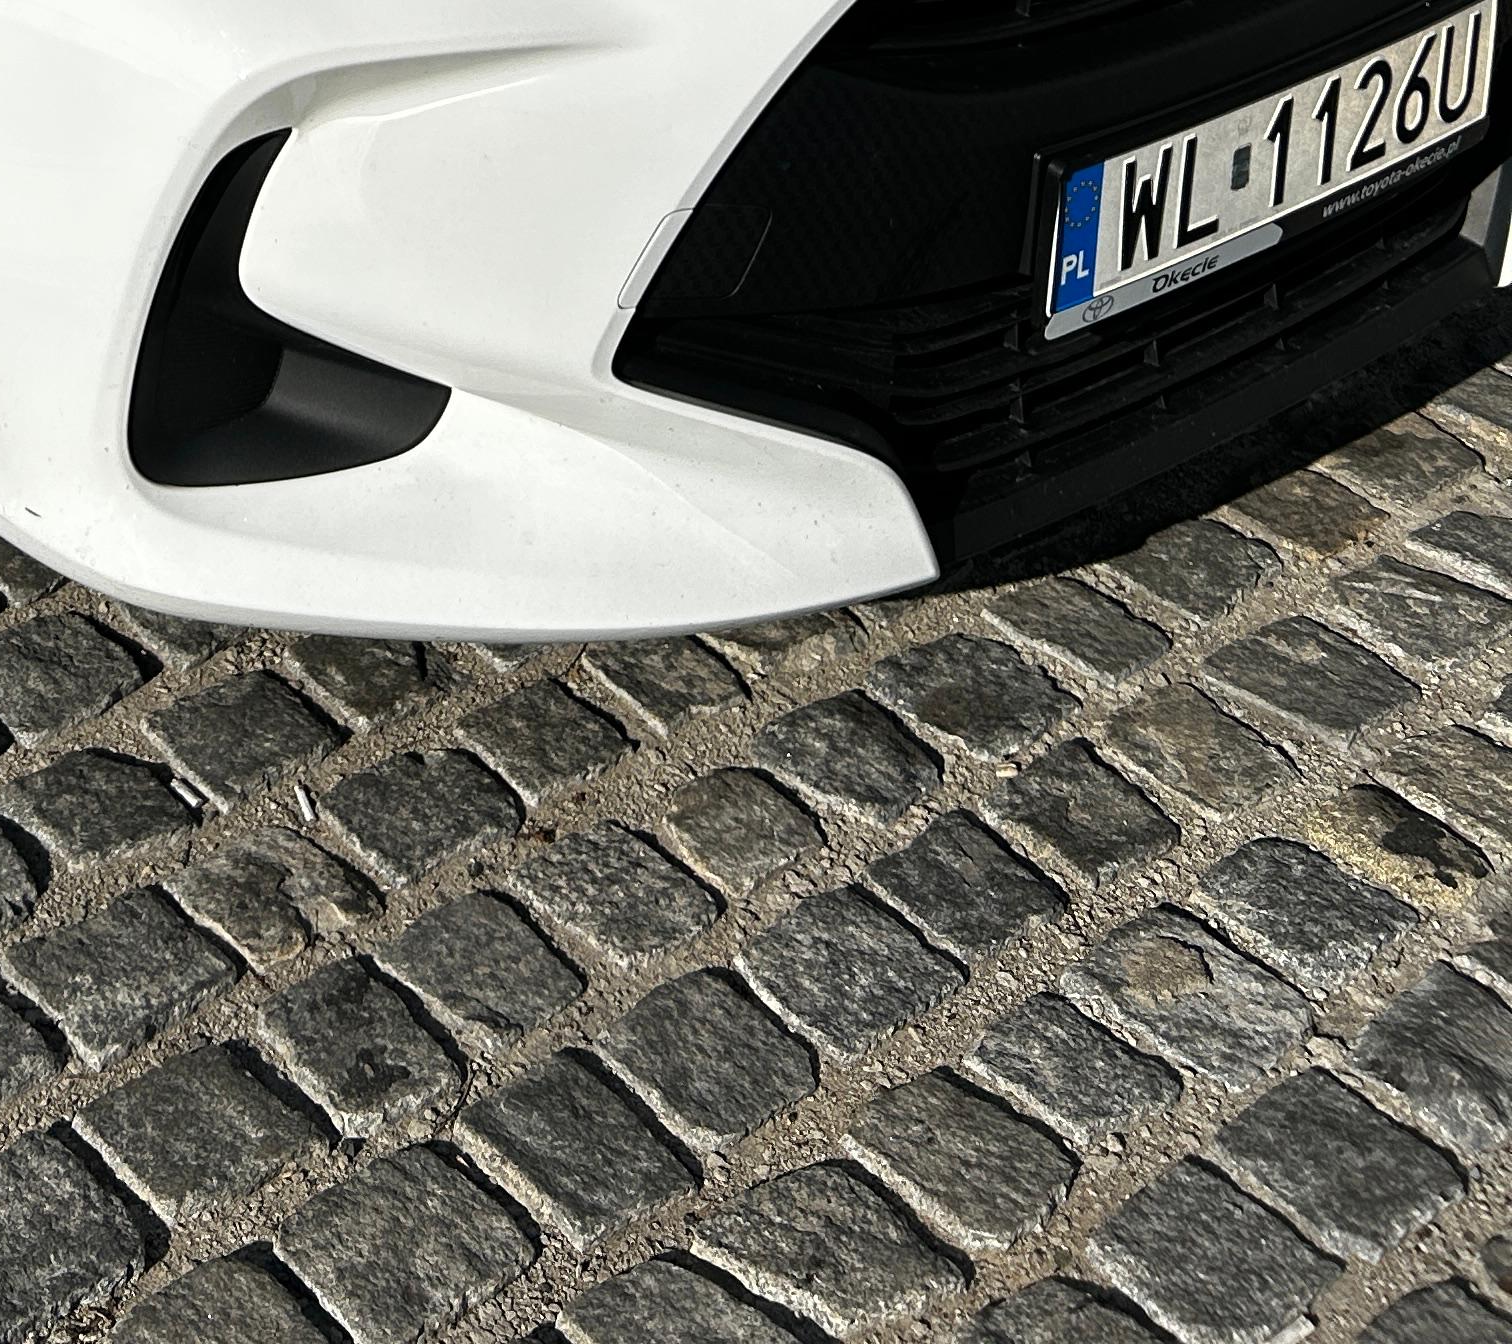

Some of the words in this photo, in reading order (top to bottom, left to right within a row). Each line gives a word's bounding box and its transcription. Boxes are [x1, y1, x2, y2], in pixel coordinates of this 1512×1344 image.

[1118, 133, 1219, 272] WL
[1264, 10, 1482, 208] 1126U
[1060, 250, 1090, 286] PL
